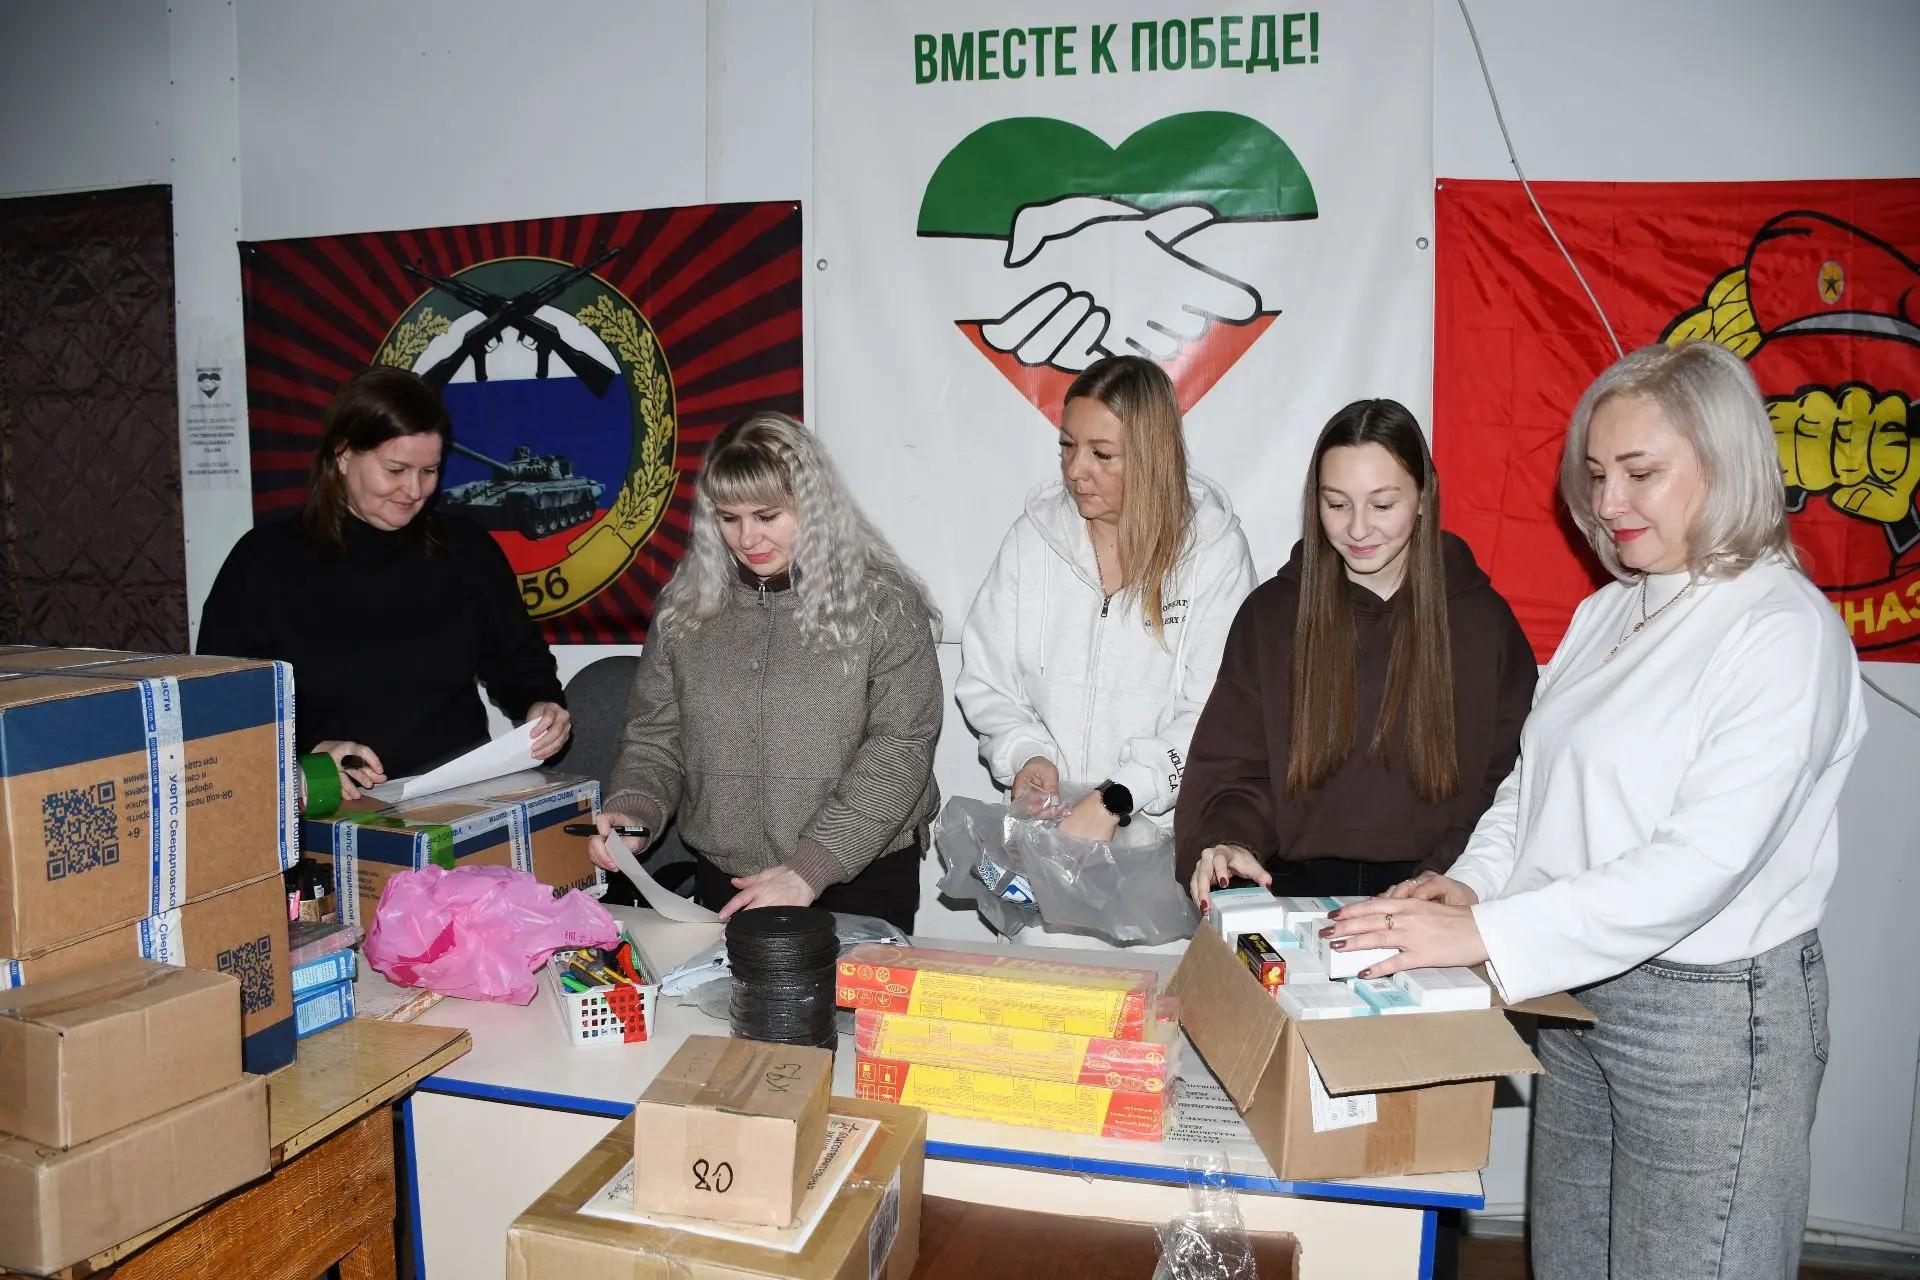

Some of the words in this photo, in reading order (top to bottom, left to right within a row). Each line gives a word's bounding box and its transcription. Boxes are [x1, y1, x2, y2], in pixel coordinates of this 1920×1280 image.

[914, 25, 1077, 84] ВМЕСТЕ
[1091, 23, 1119, 74] К
[1131, 12, 1320, 74] ПОБЕДЕ!
[521, 566, 569, 610] 56
[1162, 599, 1188, 611] OPERT
[1831, 580, 1920, 636] НАЗ
[1167, 748, 1185, 778] HOLL
[168, 774, 179, 816] УФПС
[168, 819, 179, 909] Свердловско
[158, 923, 169, 963] Сверд
[692, 1158, 734, 1194] 80
